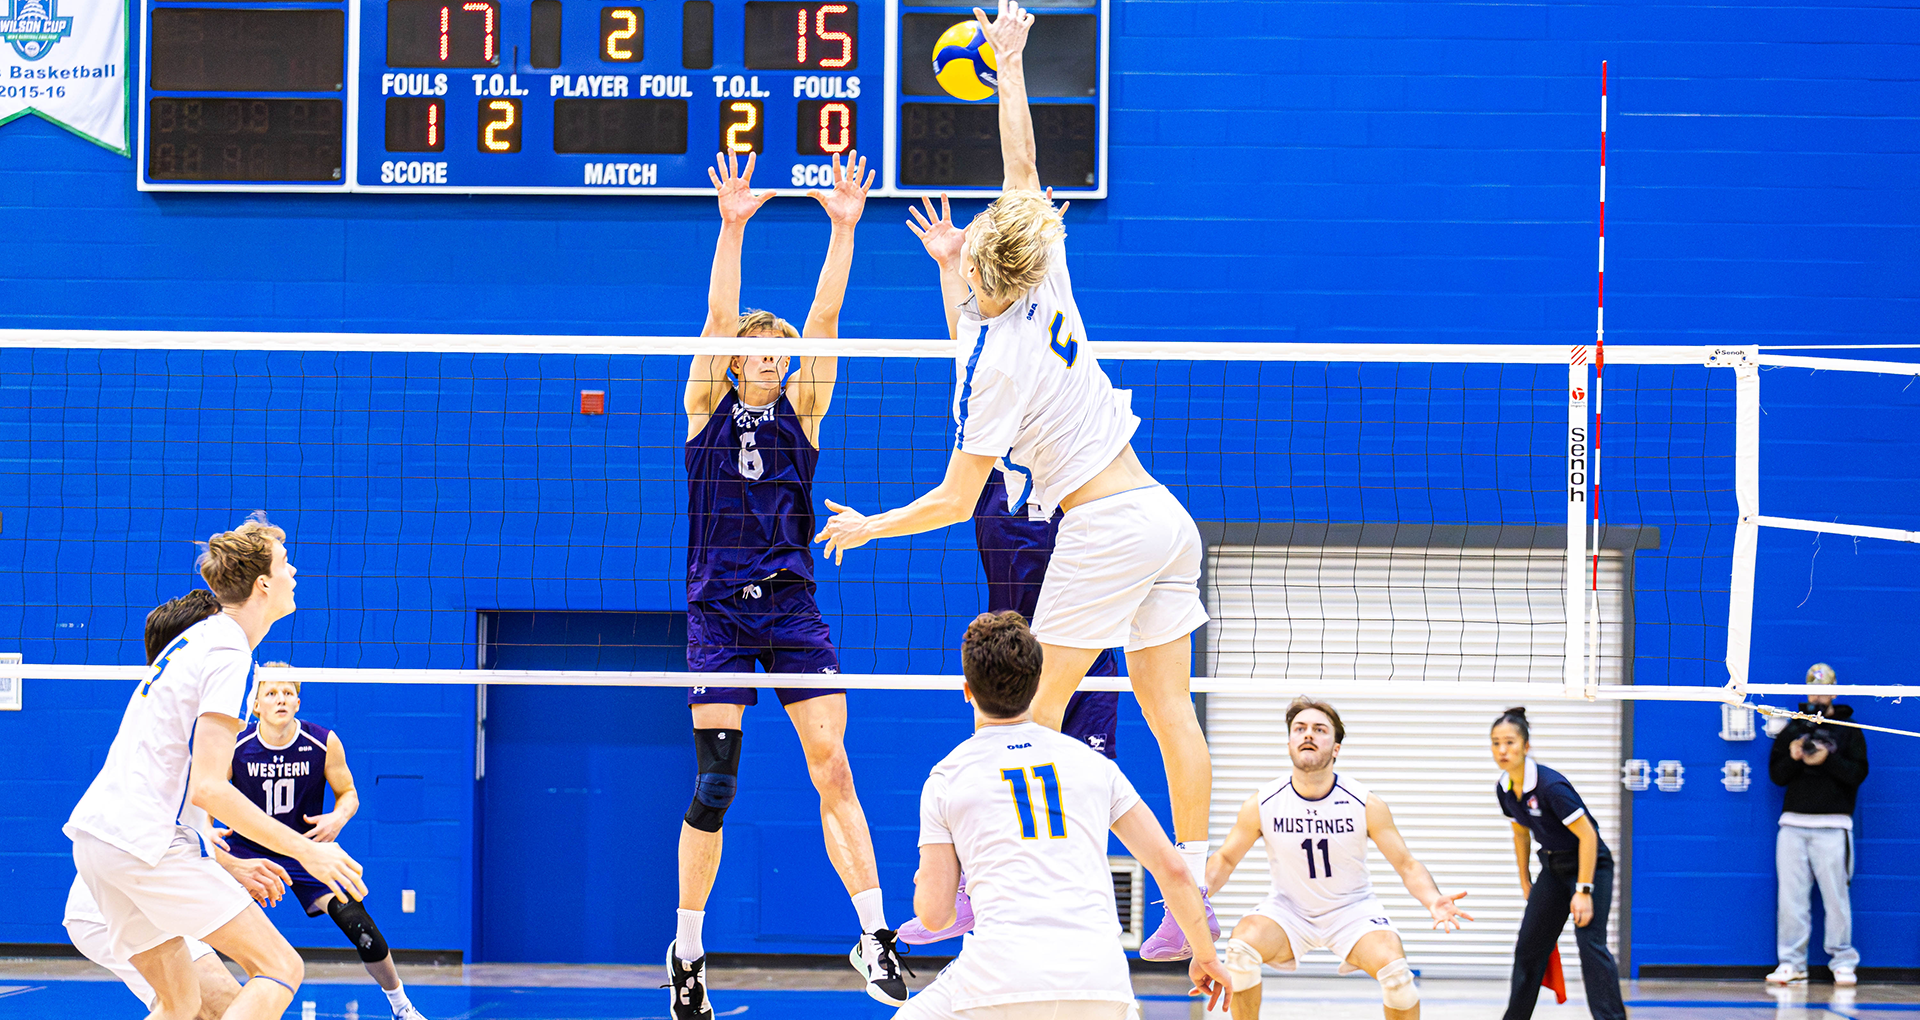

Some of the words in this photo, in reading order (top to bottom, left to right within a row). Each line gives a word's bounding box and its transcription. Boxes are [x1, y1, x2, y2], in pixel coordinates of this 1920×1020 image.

[0, 20, 42, 33] WILSON
[43, 20, 66, 33] CUP
[439, 2, 494, 61] 17
[607, 9, 637, 60] 2
[797, 5, 852, 67] 15
[10, 64, 115, 79] Basketball
[0, 86, 66, 98] 2015-16
[381, 73, 448, 96] FOULS
[472, 74, 529, 96] T.O.L.
[550, 74, 629, 97] PLAYER
[640, 74, 693, 97] FOUL
[712, 75, 770, 98] T.O.L.
[793, 75, 861, 99] FOULS
[428, 103, 437, 147] 1
[484, 100, 515, 151] 2
[726, 102, 757, 152] 2
[819, 103, 850, 152] 0
[381, 161, 448, 184] SCORE
[584, 162, 657, 185] MATCH
[738, 431, 764, 480] 6
[1570, 427, 1585, 502] Senoh
[1006, 742, 1032, 750] OUA
[247, 761, 310, 777] WESTERN
[262, 778, 295, 816] 10
[1000, 762, 1067, 840] 11
[1273, 817, 1354, 834] MUSTANGS
[1301, 838, 1332, 879] 11
